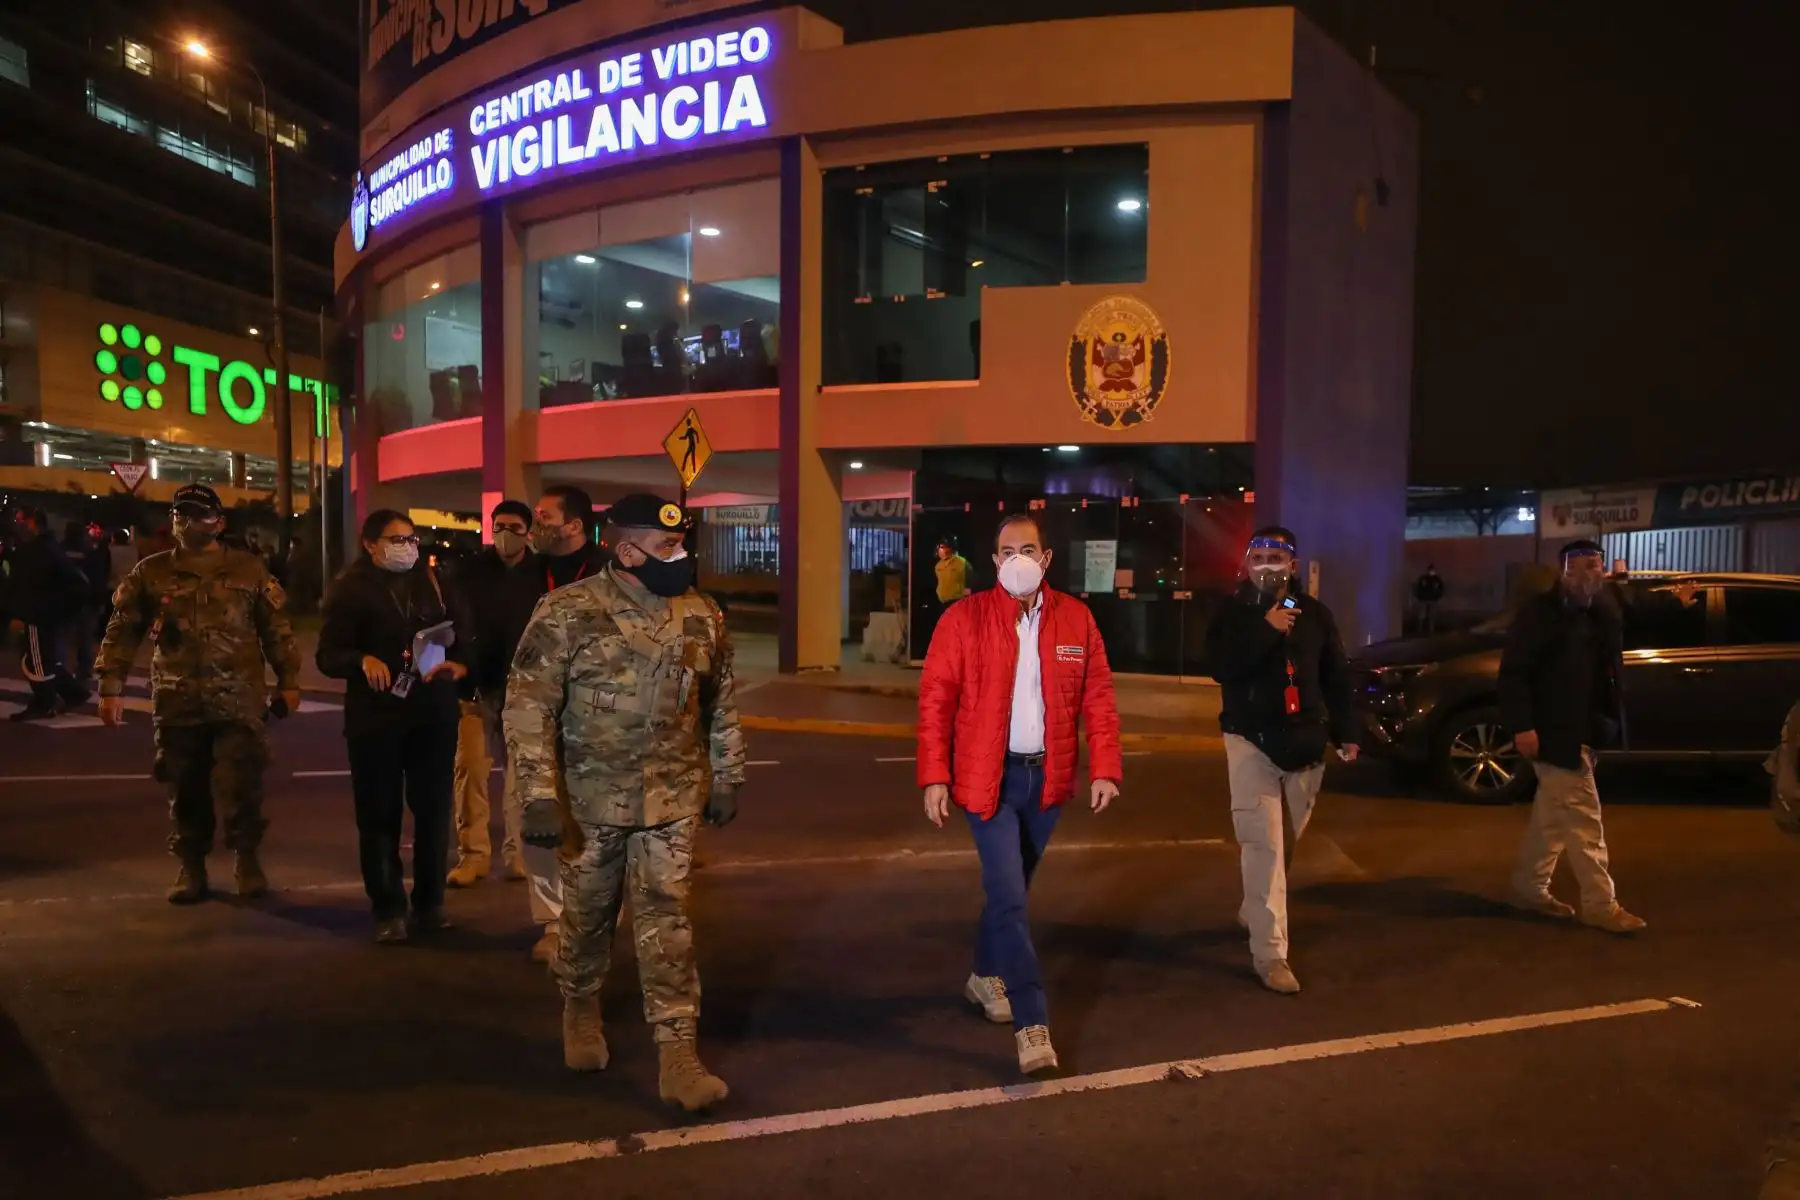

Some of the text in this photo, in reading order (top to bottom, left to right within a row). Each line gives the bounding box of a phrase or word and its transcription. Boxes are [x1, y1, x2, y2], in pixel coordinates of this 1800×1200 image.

[470, 26, 770, 136] CENTRAL DE VIDEO
[370, 127, 451, 194] MUNICIPALIDAD DE
[471, 75, 767, 190] VIGILANCIA
[370, 157, 452, 226] SURQUILLO
